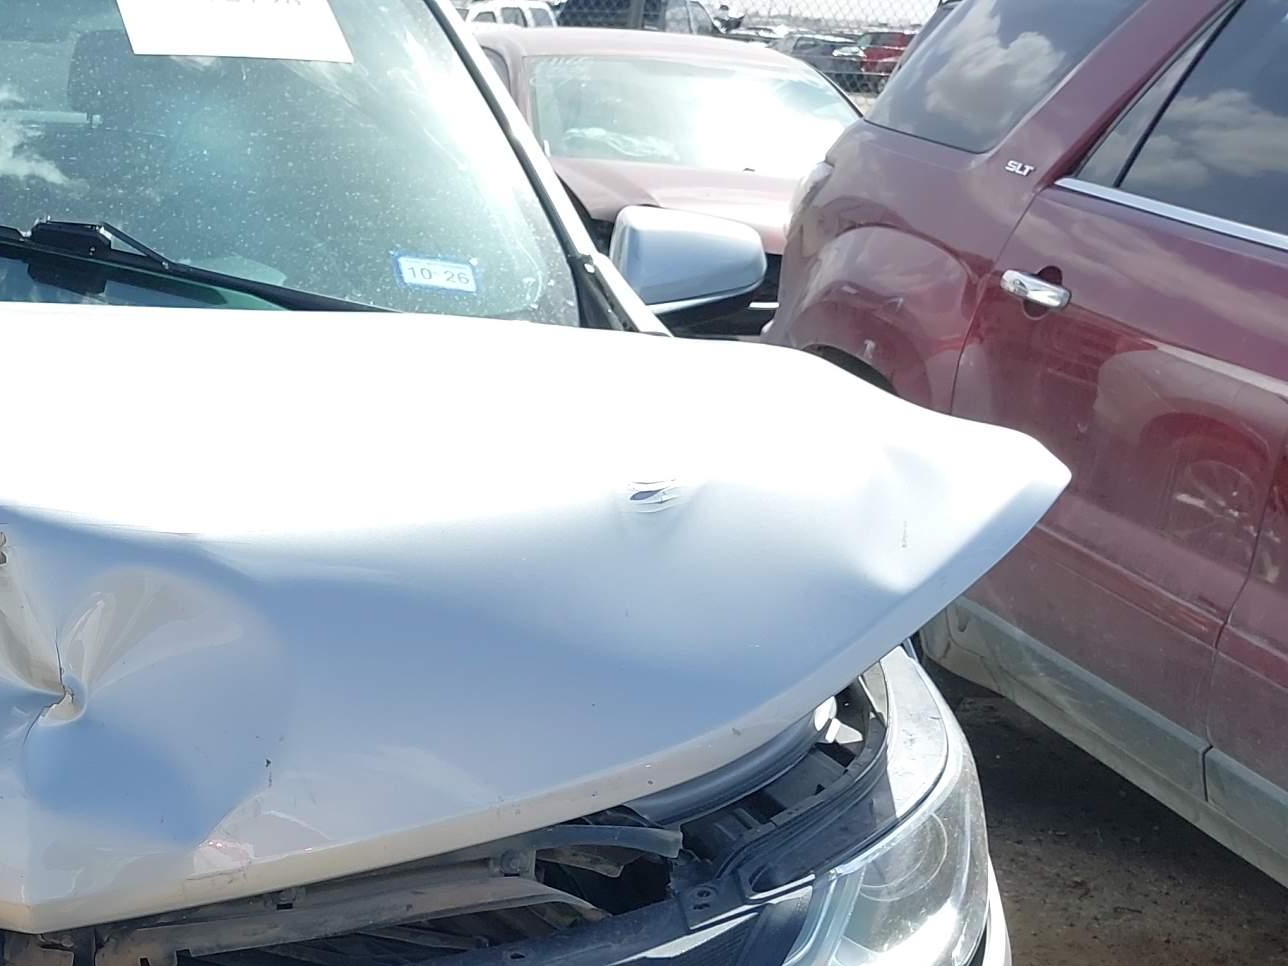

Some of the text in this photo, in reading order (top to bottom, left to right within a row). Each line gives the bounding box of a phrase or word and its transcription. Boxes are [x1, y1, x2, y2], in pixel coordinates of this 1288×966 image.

[1004, 159, 1035, 177] SLT
[407, 265, 471, 285] 10 26
